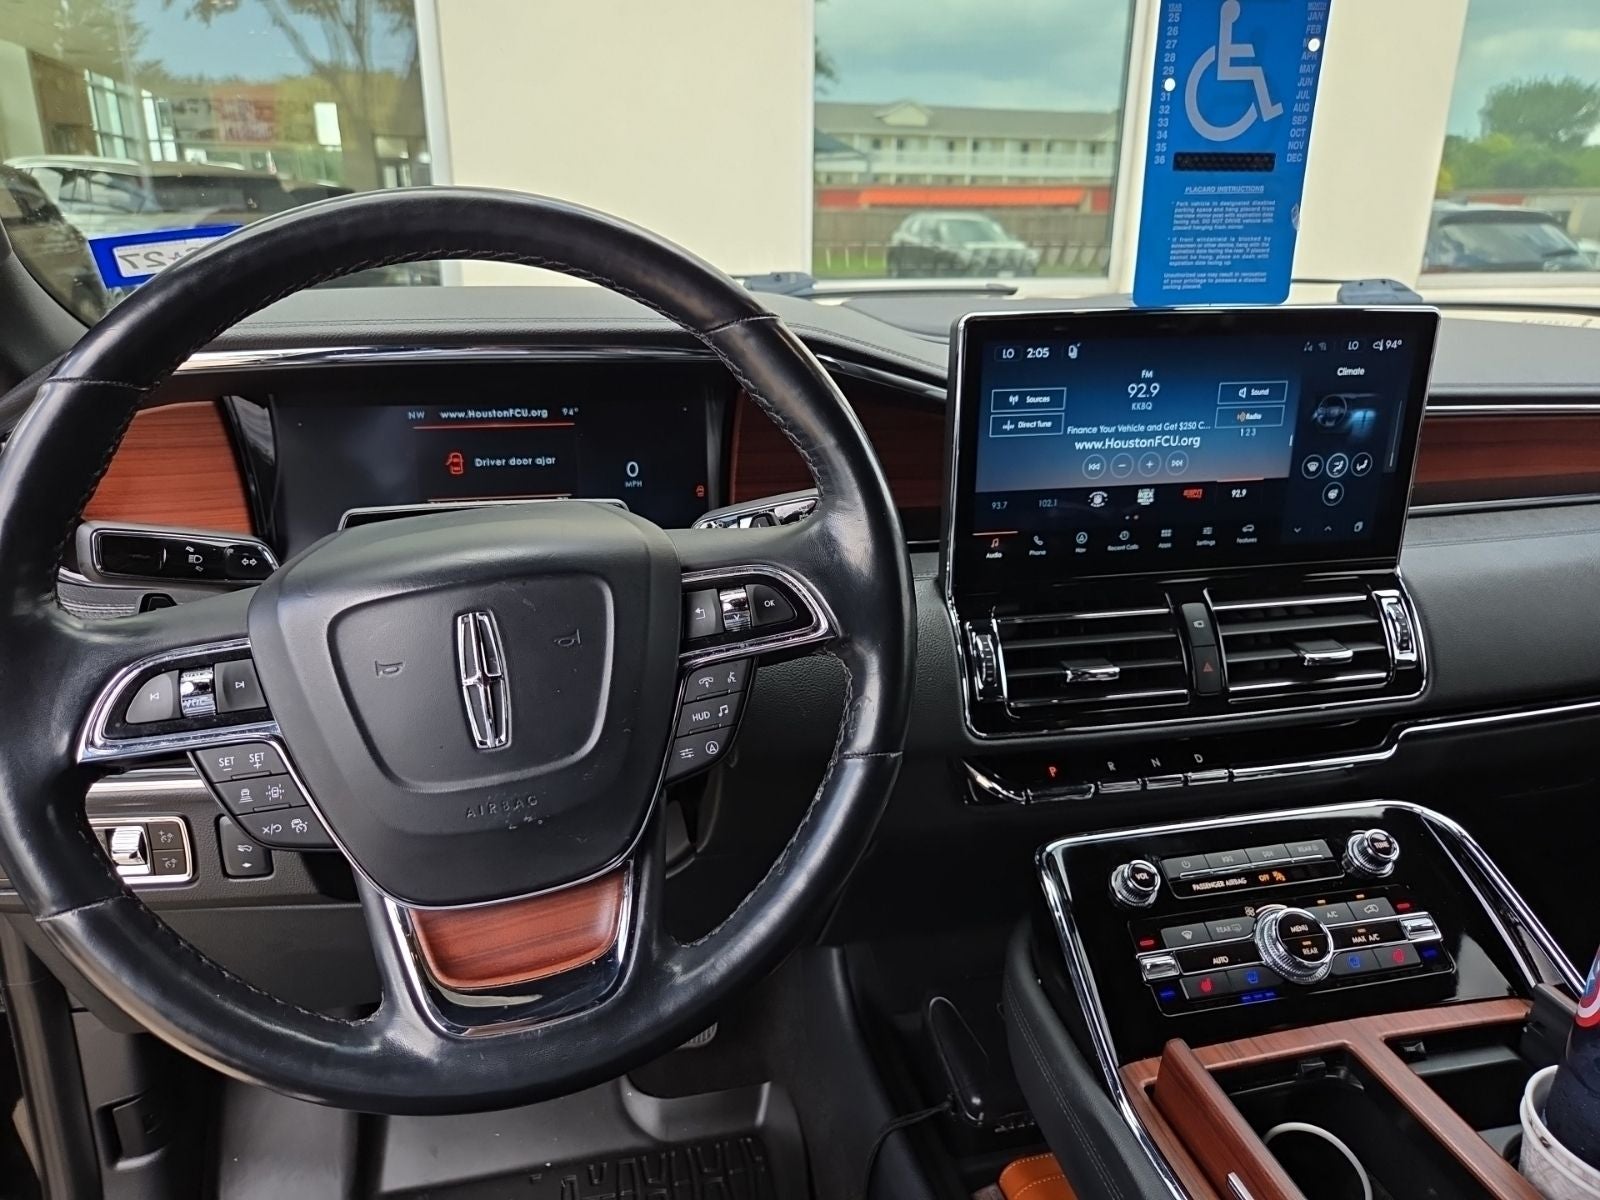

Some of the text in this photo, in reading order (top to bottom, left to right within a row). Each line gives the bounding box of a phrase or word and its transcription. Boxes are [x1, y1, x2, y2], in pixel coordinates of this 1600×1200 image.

[1168, 14, 1180, 22] 25
[1307, 12, 1324, 21] JAN
[1167, 27, 1179, 36] 26
[1306, 25, 1321, 34] FEB
[1166, 40, 1177, 49] 27
[1164, 53, 1176, 62] 28
[1162, 66, 1174, 75] 29
[1300, 64, 1316, 73] MAY
[1298, 78, 1313, 87] JUN
[1160, 92, 1171, 101] 31
[1296, 91, 1310, 100] JUL
[1159, 106, 1170, 114] 32
[1293, 103, 1310, 112] AUG
[1158, 118, 1168, 127] 33
[1292, 116, 1308, 125] SEP
[1156, 130, 1168, 139] 34
[1290, 128, 1306, 138] OCT
[1155, 143, 1167, 152] 35
[1288, 141, 1305, 150] NOV
[1154, 156, 1166, 164] 36
[1286, 154, 1303, 163] DEC
[1026, 348, 1050, 359] 2:05
[1141, 370, 1153, 378] FM
[1336, 366, 1366, 376] Climate
[1127, 382, 1160, 398] 92.9
[1250, 388, 1270, 396] Sound
[1026, 394, 1050, 404] Sources
[408, 411, 425, 420] NW
[440, 408, 548, 420] www.HoustonFCU.org
[1018, 420, 1052, 429] Direct Tune
[1066, 426, 1098, 435] Finance
[1099, 425, 1116, 434] Your
[1118, 424, 1145, 433] Vehicle
[1147, 423, 1162, 432] and
[1164, 422, 1178, 431] Get
[1179, 422, 1197, 432] $250
[1074, 434, 1201, 450] www.HoustonFCU.org
[474, 455, 556, 468] Driver door ajar
[626, 461, 640, 478] 0
[624, 480, 643, 488] MPH
[992, 488, 1247, 510] 93.7 102.1 92.9
[764, 600, 776, 608] OK
[692, 711, 710, 722] HUD
[218, 756, 235, 767] SET
[249, 752, 265, 764] SET
[1049, 754, 1204, 778] P R N D
[466, 795, 538, 818] AIRBAG
[1134, 872, 1150, 880] VOL
[1258, 874, 1270, 882] OFF
[1192, 877, 1248, 891] PASSENGER AIRBAG
[1326, 910, 1339, 918] A/C
[1290, 924, 1309, 934] MENU
[1352, 933, 1380, 944] MAX A/C
[1302, 948, 1318, 956] REAR
[1212, 956, 1229, 964] AUTO
